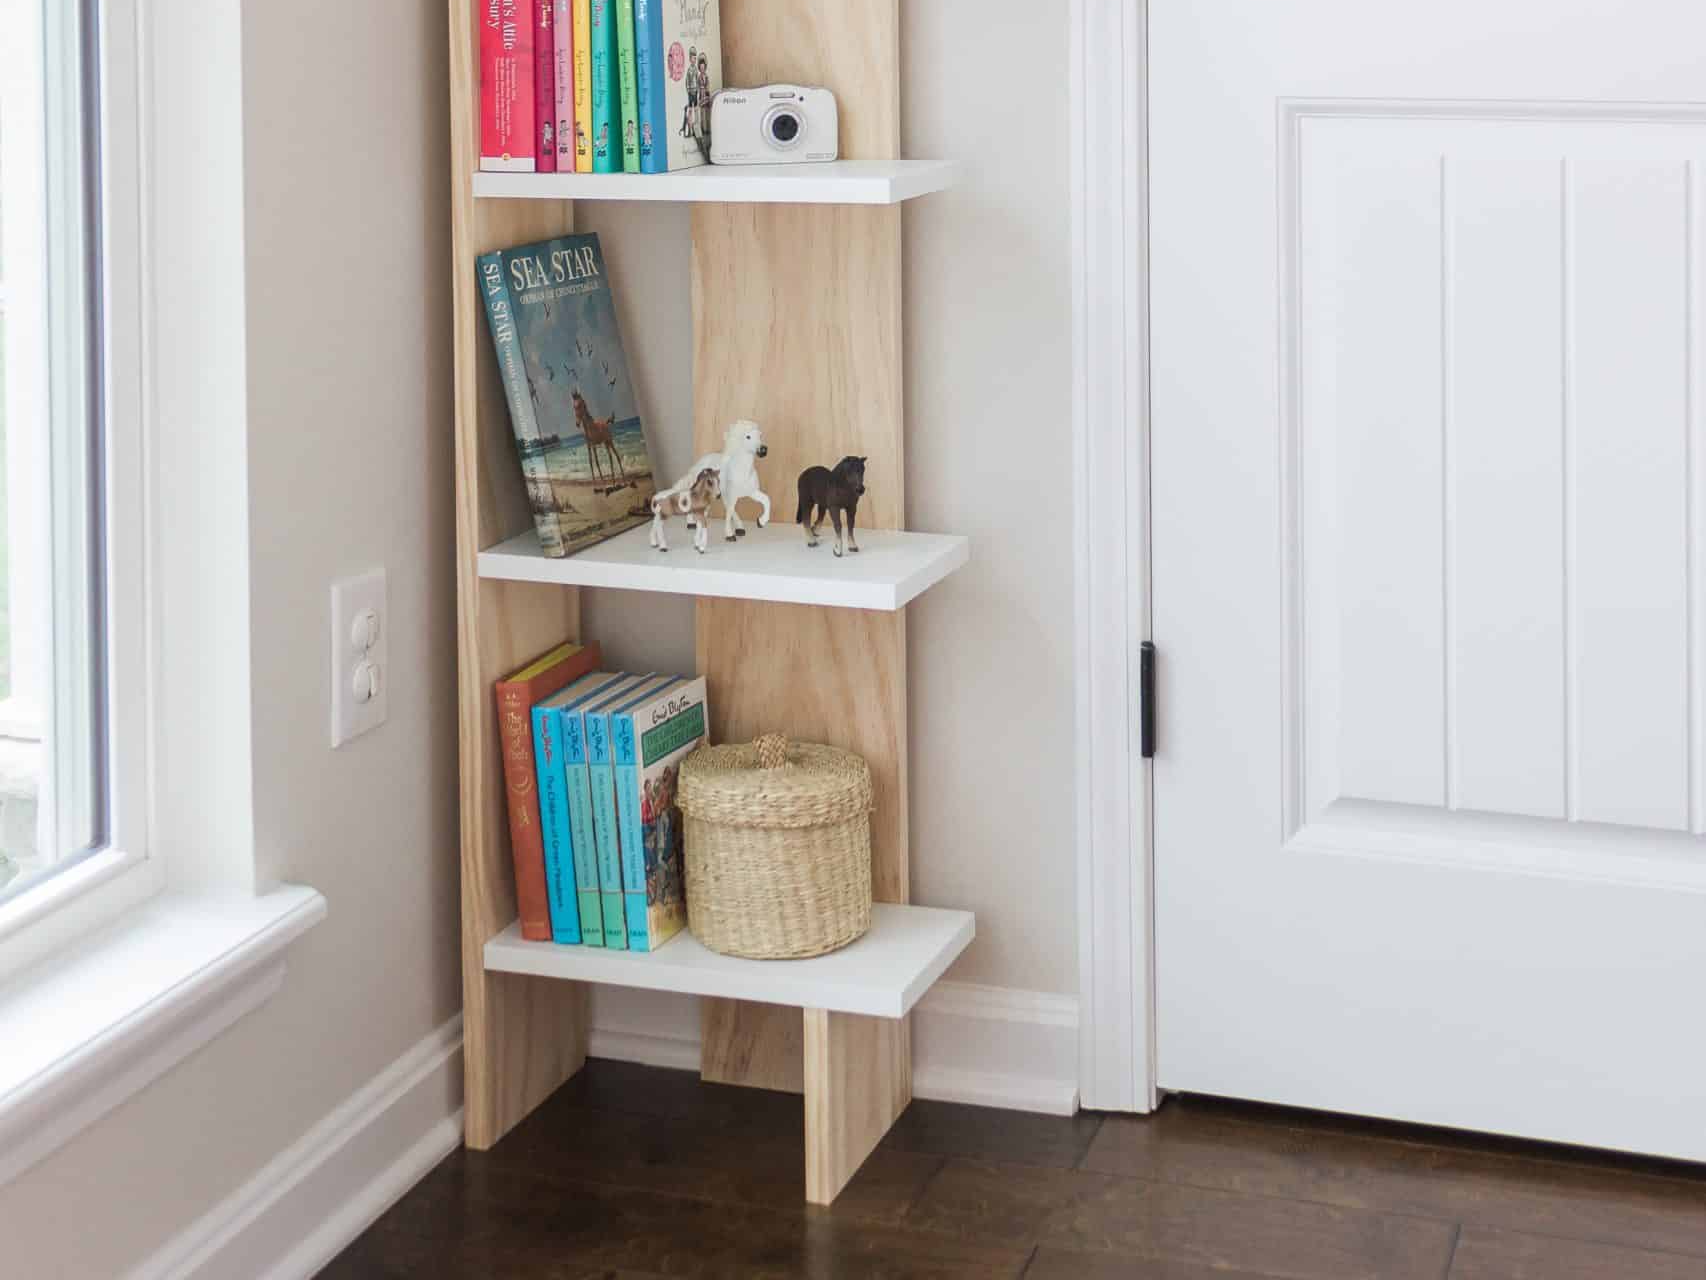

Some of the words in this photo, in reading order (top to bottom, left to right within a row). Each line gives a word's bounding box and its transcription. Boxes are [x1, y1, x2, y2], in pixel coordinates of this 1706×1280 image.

[503, 21, 517, 50] Attic
[484, 263, 501, 297] SEA
[511, 255, 550, 292] SEA
[551, 246, 599, 282] STAR
[491, 301, 512, 344] STAR
[652, 704, 668, 725] Enid
[668, 696, 691, 716] Blyton
